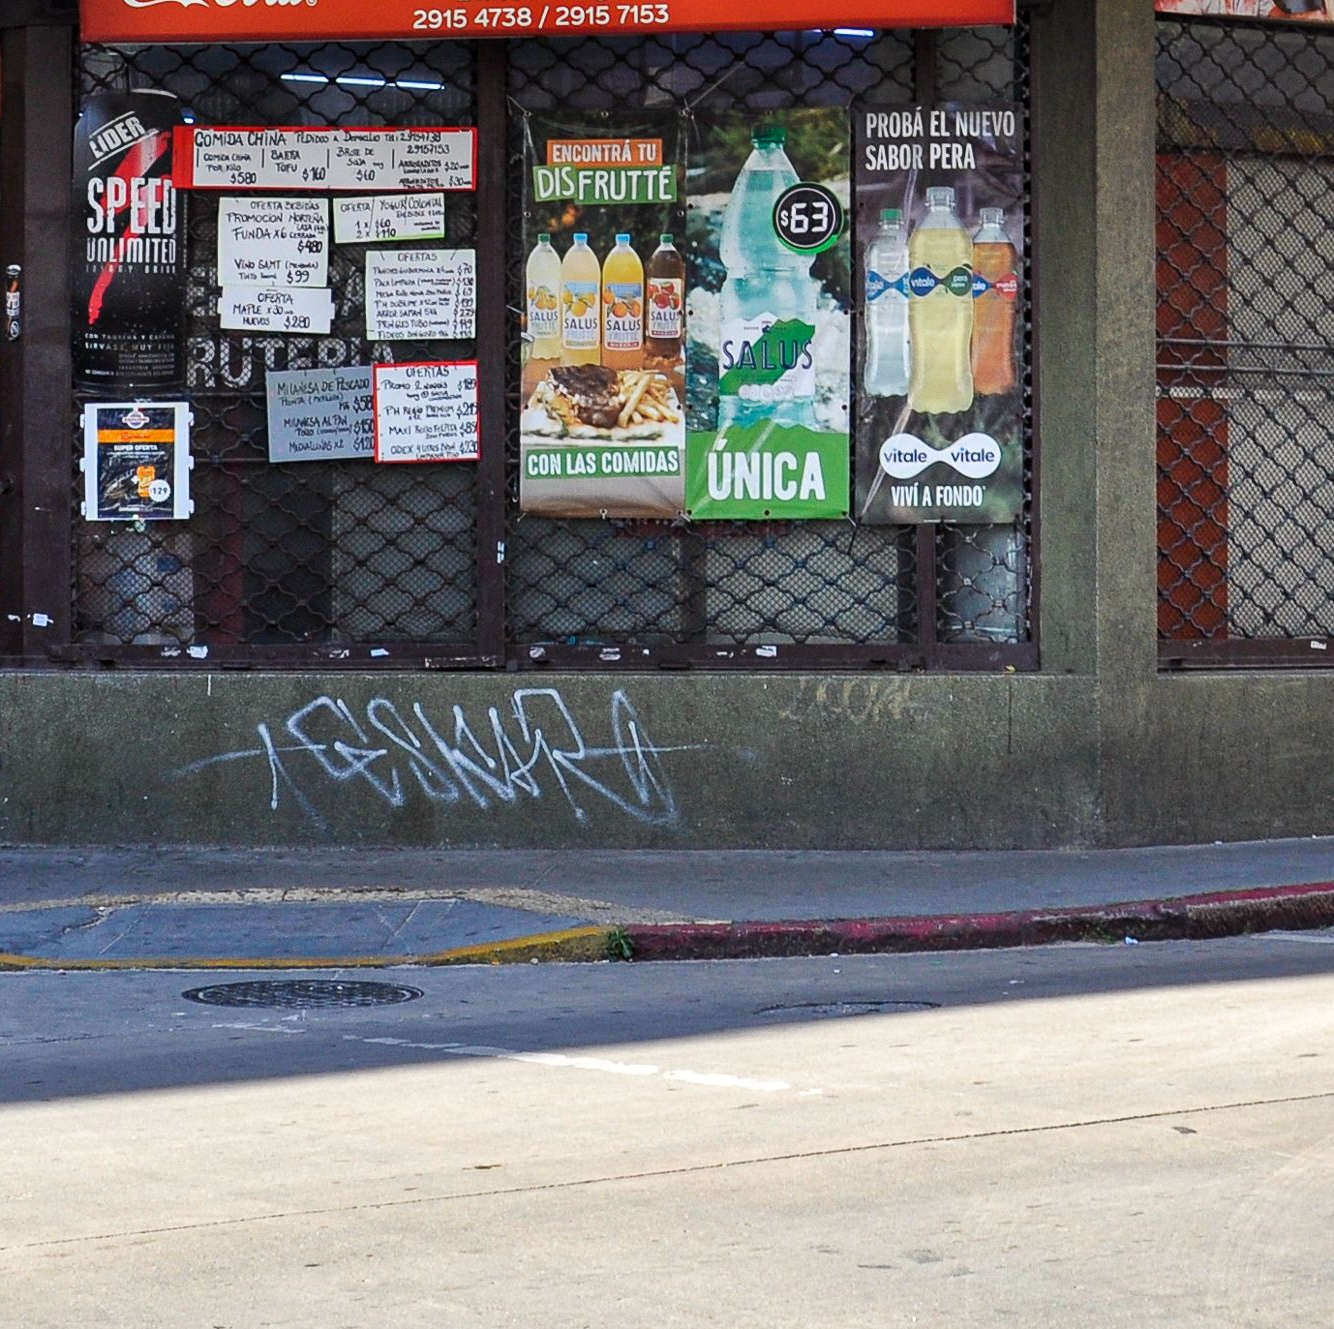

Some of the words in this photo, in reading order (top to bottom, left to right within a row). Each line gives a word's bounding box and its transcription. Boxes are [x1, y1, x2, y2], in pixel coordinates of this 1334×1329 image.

[413, 8, 467, 29] 2915
[474, 6, 532, 27] 4738
[538, 5, 549, 29] /
[555, 5, 610, 26] 2915
[616, 3, 669, 24] 7153
[866, 106, 923, 138] PROBÁ
[930, 111, 950, 136] EL
[955, 110, 1015, 137] NUEVO
[89, 116, 146, 159] LIDER
[194, 131, 244, 147] COMIDA
[247, 131, 287, 147] CHINA
[552, 140, 632, 163] ENCONTRÁ
[637, 143, 657, 160] TU
[866, 143, 923, 170] SABOR
[930, 142, 976, 169] PERA
[536, 166, 674, 202] DISFRUTTÉ
[87, 176, 177, 234] SPEED
[780, 202, 829, 234] $63
[86, 236, 177, 264] UNLIMITED
[530, 311, 559, 322] SALUS
[564, 318, 598, 330] SALUS
[606, 319, 641, 331] SALUS
[651, 311, 680, 322] SALUS
[722, 339, 813, 370] SALUS
[527, 451, 562, 475] CON
[567, 451, 596, 474] LAS
[601, 449, 679, 474] COMIDAS
[884, 449, 928, 464] vitale
[950, 446, 995, 462] vitale
[708, 438, 826, 502] ÚNICA
[891, 482, 919, 507] VIVÍ
[922, 485, 933, 506] A
[935, 484, 983, 507] FONDO
